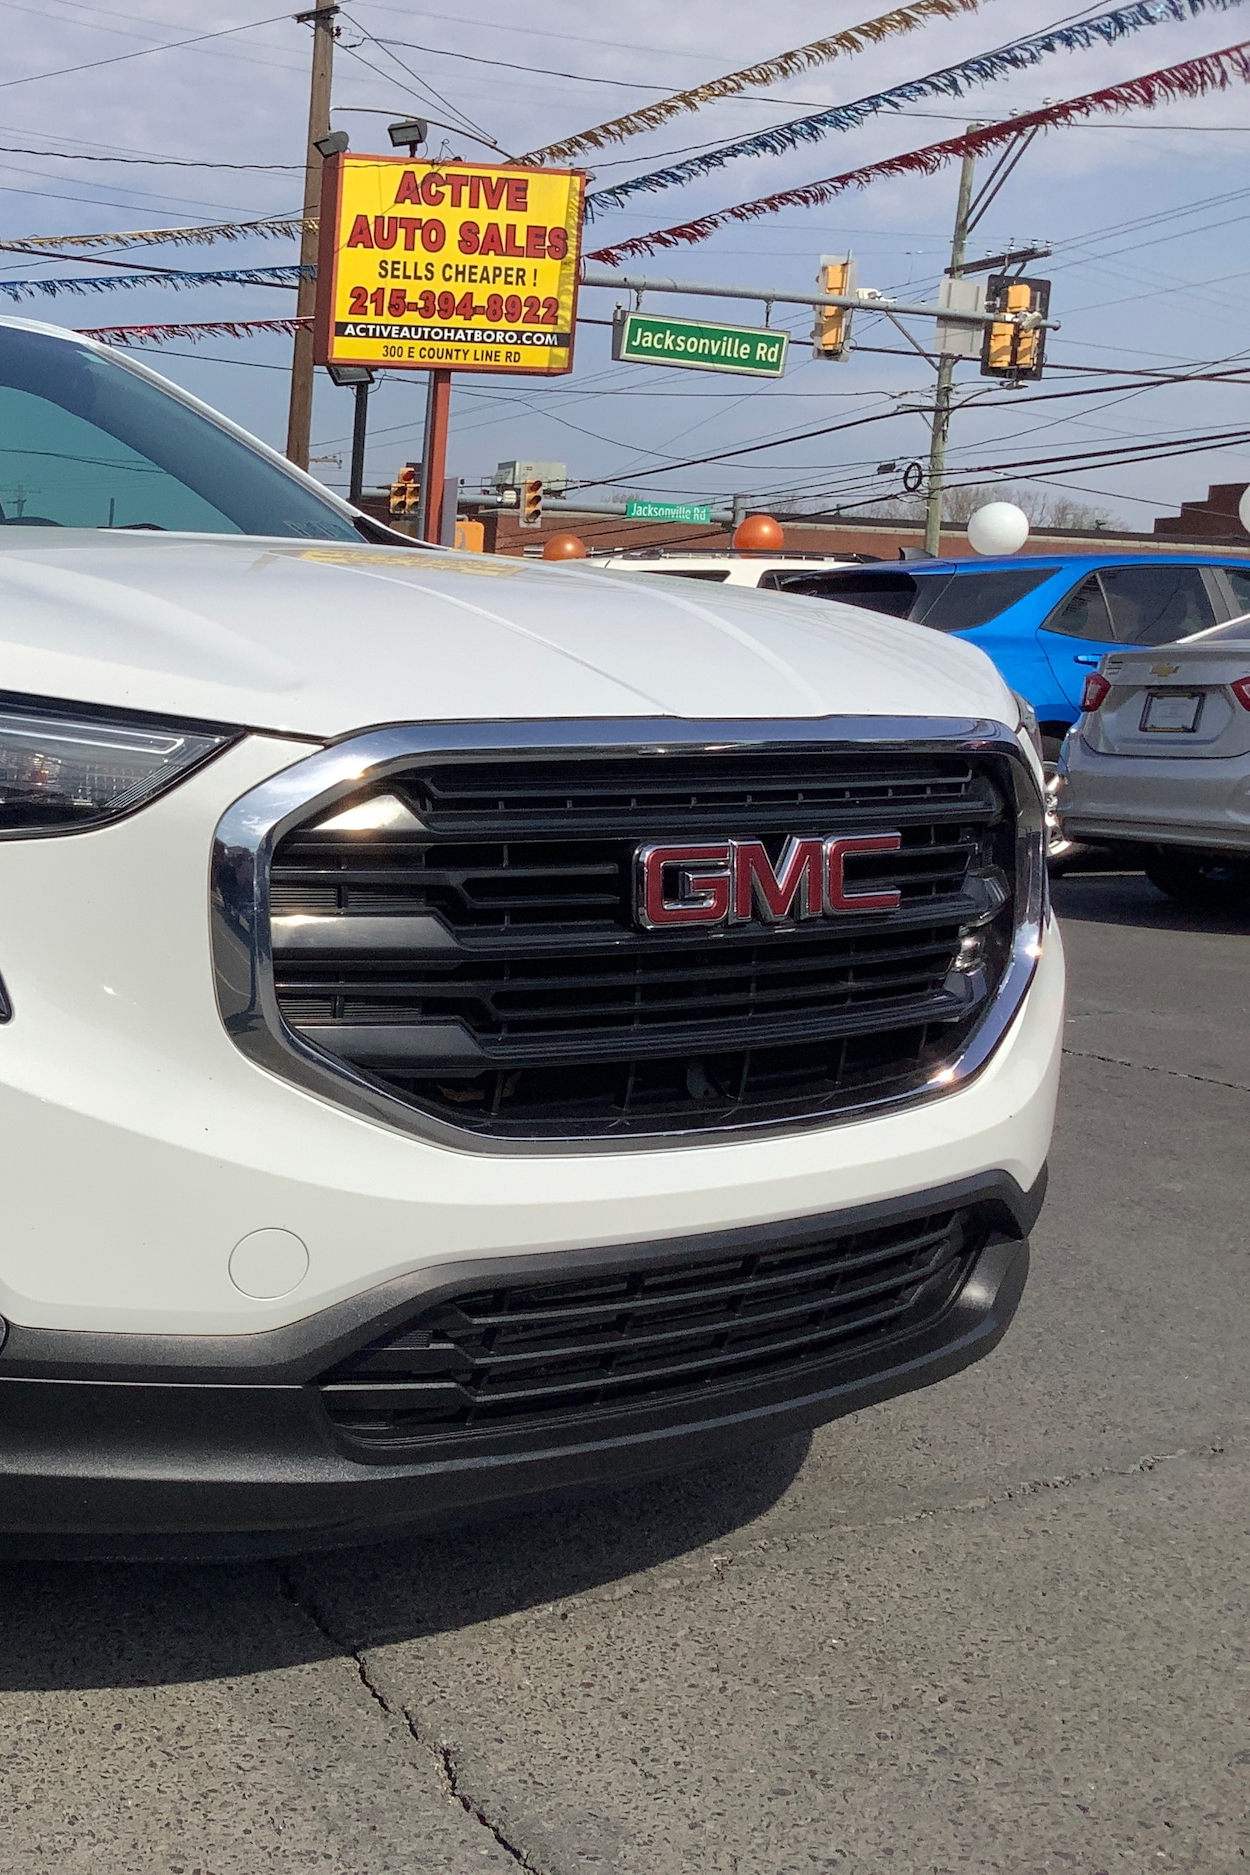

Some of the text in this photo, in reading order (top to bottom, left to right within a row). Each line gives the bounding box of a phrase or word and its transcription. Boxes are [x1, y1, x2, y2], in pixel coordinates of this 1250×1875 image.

[394, 171, 529, 212] ACTIVE
[347, 214, 569, 260] AUTO SALES
[378, 259, 435, 281] SELLS
[442, 263, 526, 286] CHEAPER
[348, 286, 560, 325] 215-394-8922
[344, 324, 558, 346] ACTIVEAUTOHATBORO.COM
[631, 327, 779, 363] Jacksonville Rd
[382, 345, 521, 363] 300 E COUNTY LINE RD
[631, 503, 706, 520] Jacksonville Rd
[632, 832, 902, 930] GMC
